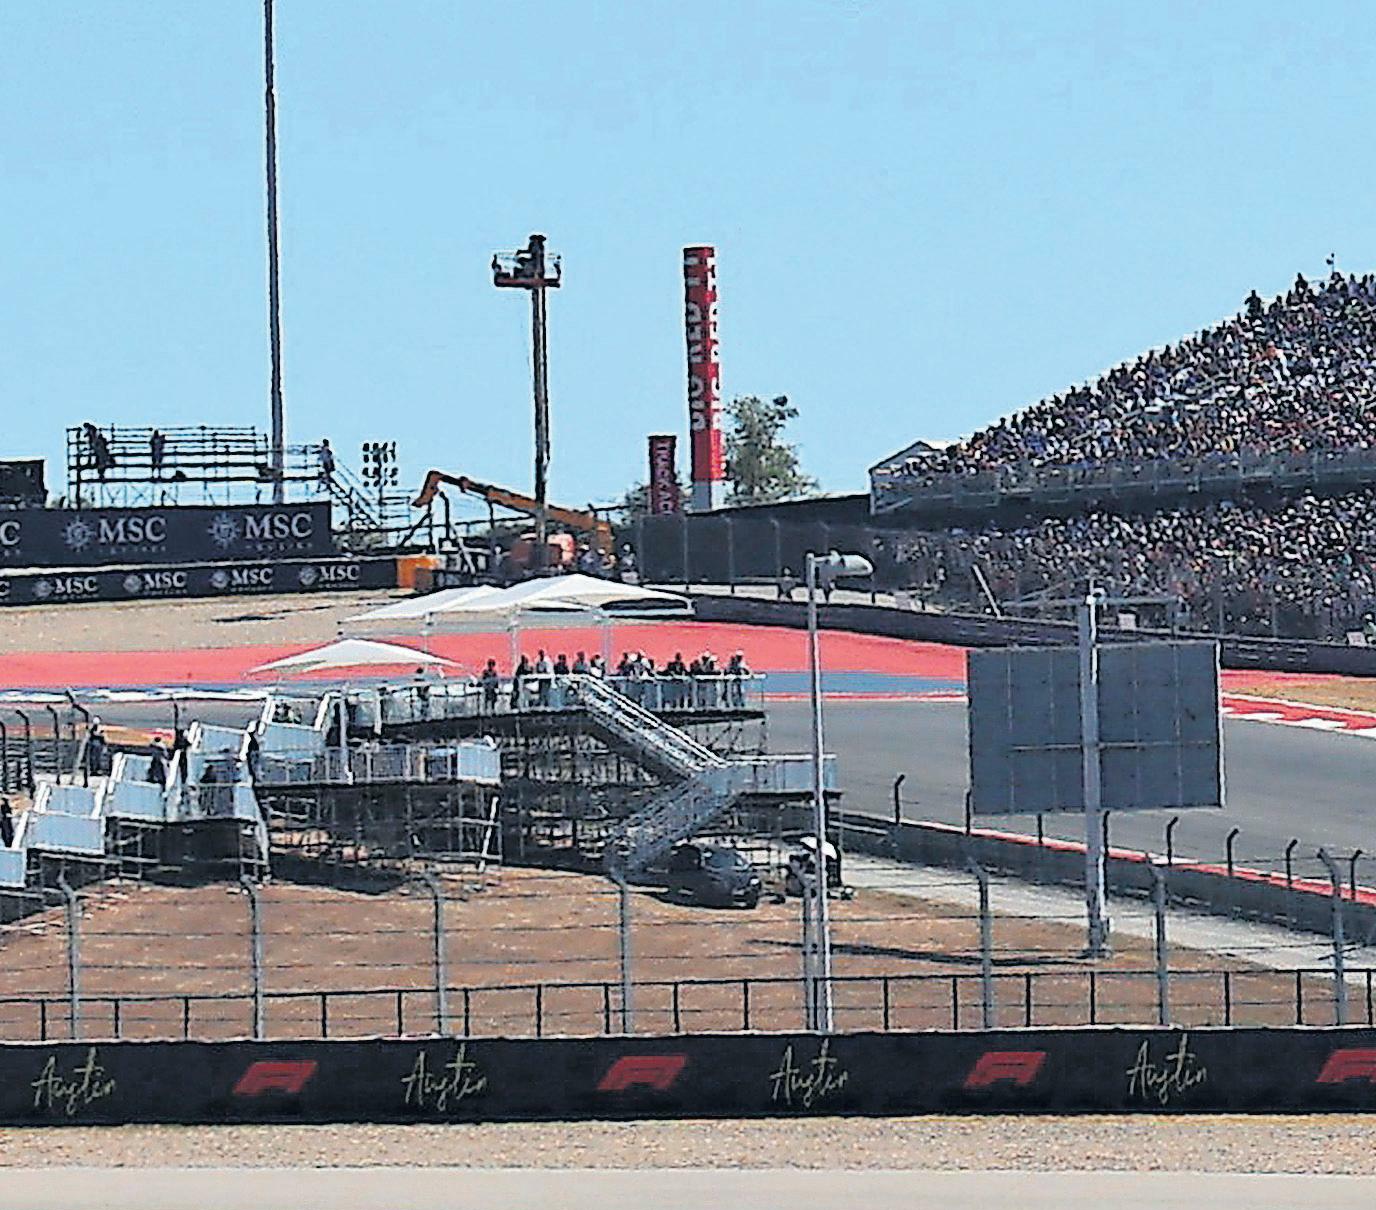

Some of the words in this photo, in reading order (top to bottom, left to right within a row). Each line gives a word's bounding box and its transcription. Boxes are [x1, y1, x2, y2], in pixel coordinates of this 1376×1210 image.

[99, 516, 167, 544] MSC
[245, 512, 313, 540] MSC
[143, 572, 187, 588] MSC
[231, 568, 273, 585] MSC
[318, 565, 360, 581] MSC
[54, 577, 99, 593] MSC
